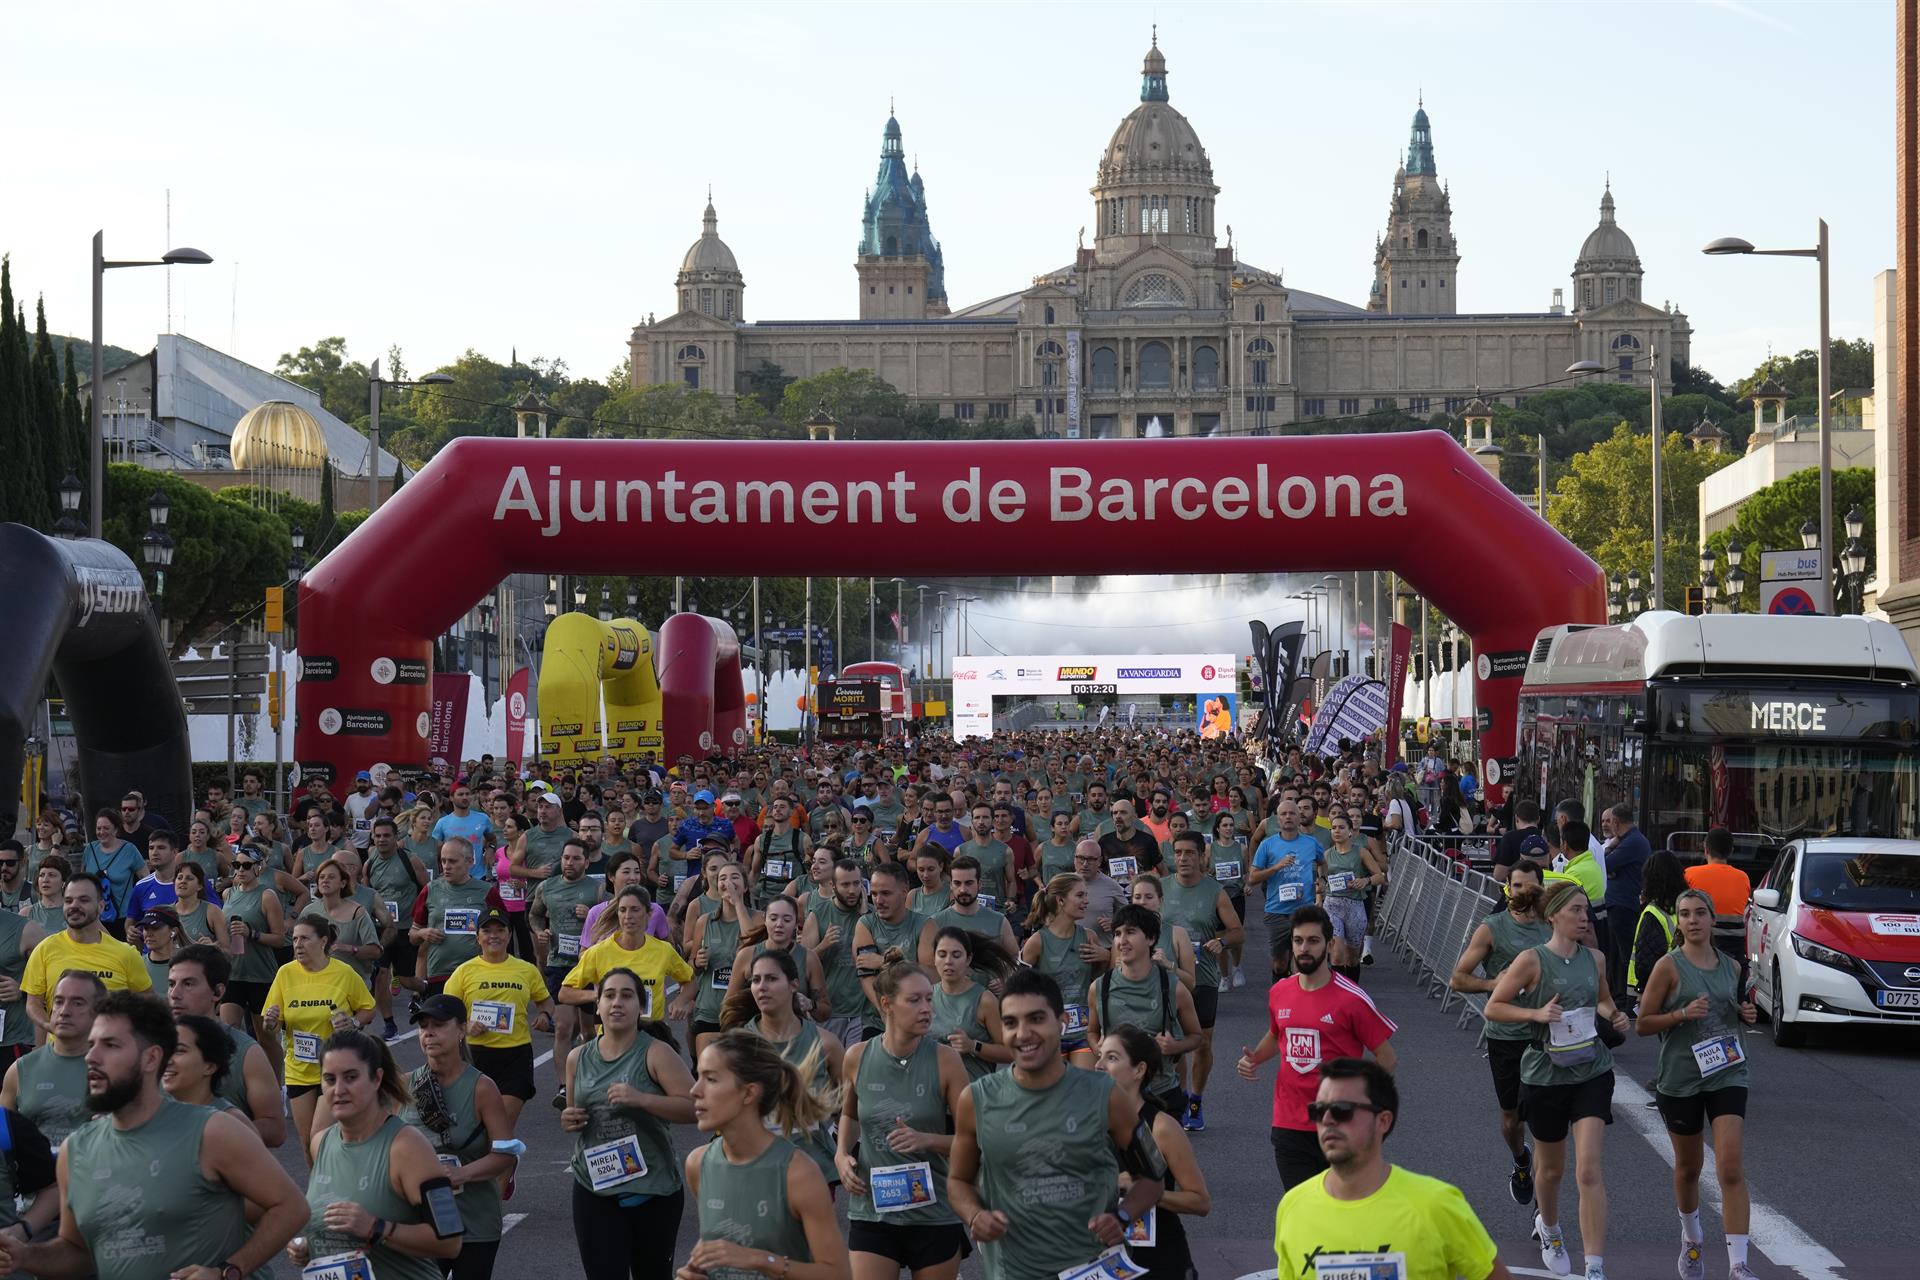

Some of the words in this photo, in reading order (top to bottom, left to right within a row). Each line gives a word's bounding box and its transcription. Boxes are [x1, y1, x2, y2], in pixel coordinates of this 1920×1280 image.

[492, 465, 917, 537] Ajuntament
[942, 466, 1026, 523] de
[1049, 463, 1408, 522] Barcelona
[93, 584, 144, 613] SCOTT
[1493, 656, 1518, 664] Ajuntament
[305, 667, 332, 676] Barcelona
[1060, 667, 1095, 675] MUNDO
[1493, 663, 1527, 672] Barcelona
[400, 670, 425, 678] Barcelona
[1118, 670, 1129, 678] LA
[1129, 669, 1180, 678] VANGUARDIA
[1073, 685, 1115, 694] 00:12:20
[833, 695, 865, 703] MORITZ
[347, 714, 375, 723] Ajuntament
[1751, 701, 1827, 731] MERCÈ
[346, 721, 384, 730] Barcelona
[431, 700, 442, 752] Diputació
[440, 701, 453, 753] Barcelona
[491, 982, 523, 990] RUBAU
[300, 999, 333, 1008] RUBAU
[1887, 992, 1919, 1005] 0775
[296, 1039, 314, 1047] SILVIA
[1292, 1035, 1313, 1047] UNI
[1292, 1046, 1313, 1057] RUN
[1698, 1047, 1721, 1060] PAULA
[1705, 1055, 1720, 1066] 6316
[590, 1153, 618, 1169] MIREIA
[597, 1163, 616, 1176] 5204
[872, 1179, 907, 1190] SABRINA
[881, 1189, 902, 1199] 2653
